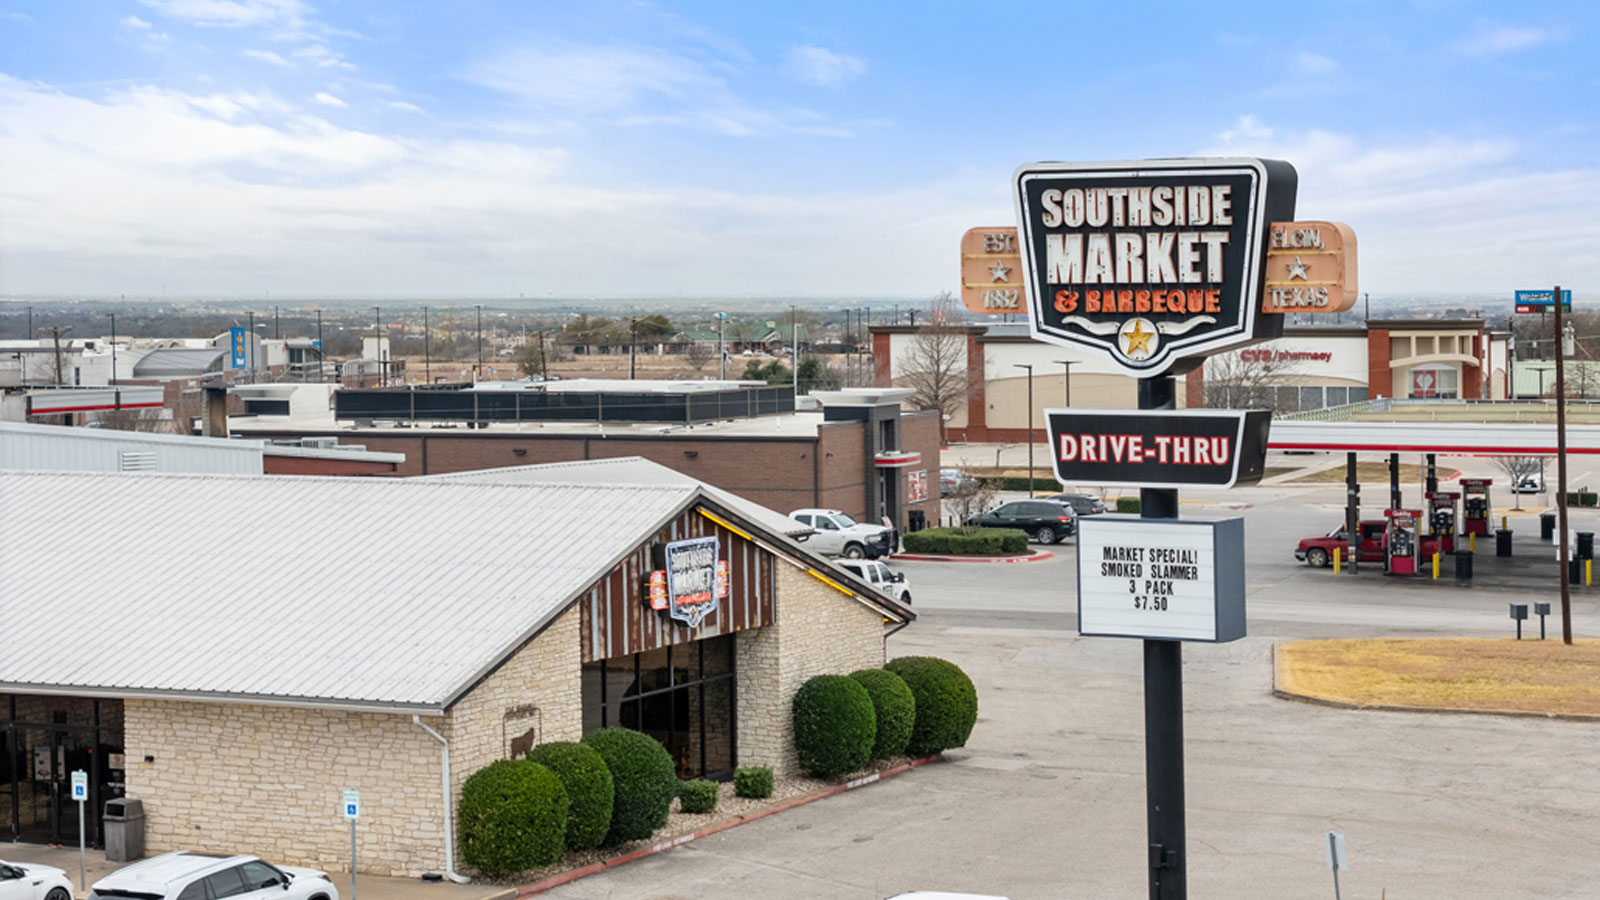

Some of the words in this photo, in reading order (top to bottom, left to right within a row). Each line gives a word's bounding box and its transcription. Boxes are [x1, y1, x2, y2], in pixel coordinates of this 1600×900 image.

[1041, 185, 1233, 228] SOUTHSIDE
[1272, 229, 1325, 250] ELGIN,
[1046, 231, 1230, 285] MARKET
[981, 289, 1019, 309] 1882
[1053, 289, 1080, 313] &
[1085, 289, 1221, 314] BARBEQUE
[1268, 287, 1329, 308] TEXAS
[1060, 434, 1230, 465] DRIVE-THRU
[1103, 546, 1145, 562] MARKET
[1149, 548, 1198, 564] SPECIAL!
[1101, 562, 1143, 578] SMOKED
[1151, 564, 1199, 580] SLAMMER
[1129, 579, 1136, 594] 3
[1145, 580, 1174, 595] PACK
[1134, 596, 1168, 611] $7.50
